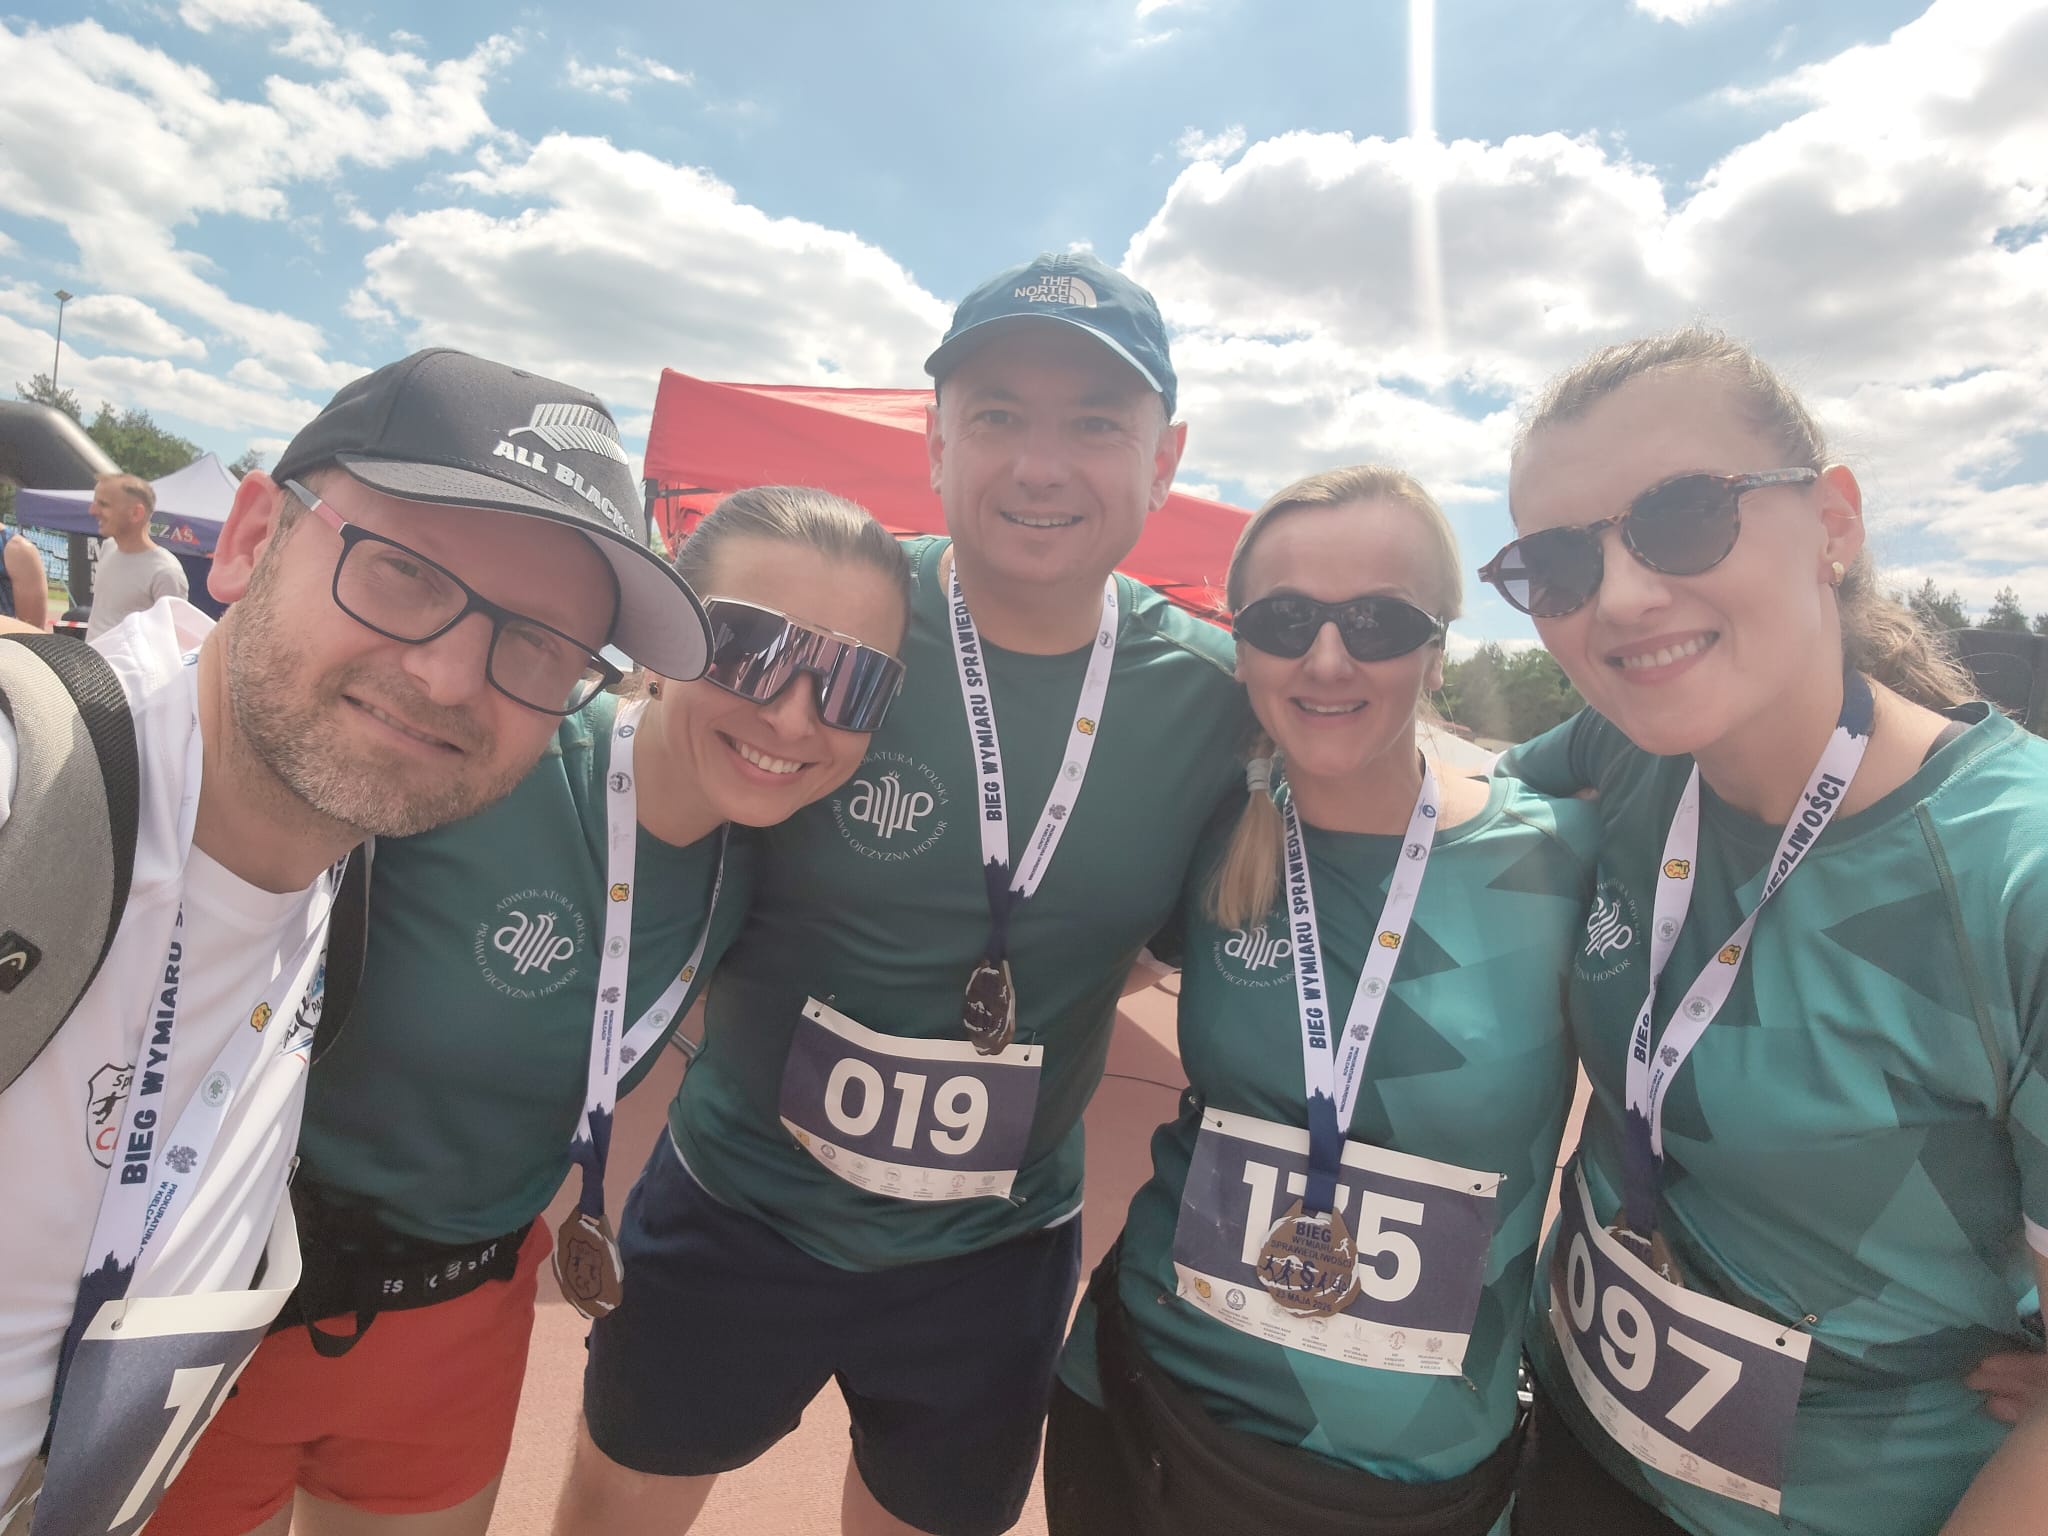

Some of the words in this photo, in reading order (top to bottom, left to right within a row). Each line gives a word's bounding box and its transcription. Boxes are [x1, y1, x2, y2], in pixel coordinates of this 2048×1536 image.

[1014, 286, 1069, 298] NORTH
[1028, 295, 1068, 304] FACE
[1040, 276, 1070, 286] THE
[493, 440, 548, 474] ALL
[554, 462, 635, 539] BLACK
[970, 693, 998, 775] WYMIARU
[984, 780, 1003, 822] BIEG
[912, 819, 949, 856] HONOR
[1760, 772, 1847, 902] IEDLIWOŚCI
[495, 888, 575, 913] ADWOKATURA
[1295, 921, 1322, 1000] WYMIARU
[481, 966, 537, 999] OJCZYZNA
[539, 966, 580, 997] HONOR
[1305, 1007, 1327, 1049] BIEG
[121, 1109, 158, 1185] BIEG
[140, 941, 183, 1097] WYMIARU
[824, 1057, 989, 1155] 019
[140, 1183, 178, 1246] PROKURATURA
[1295, 1221, 1332, 1243] BIEG
[1292, 1236, 1333, 1253] WYMIARU
[1286, 1292, 1311, 1305] MAJA
[1567, 1231, 1743, 1433] 097
